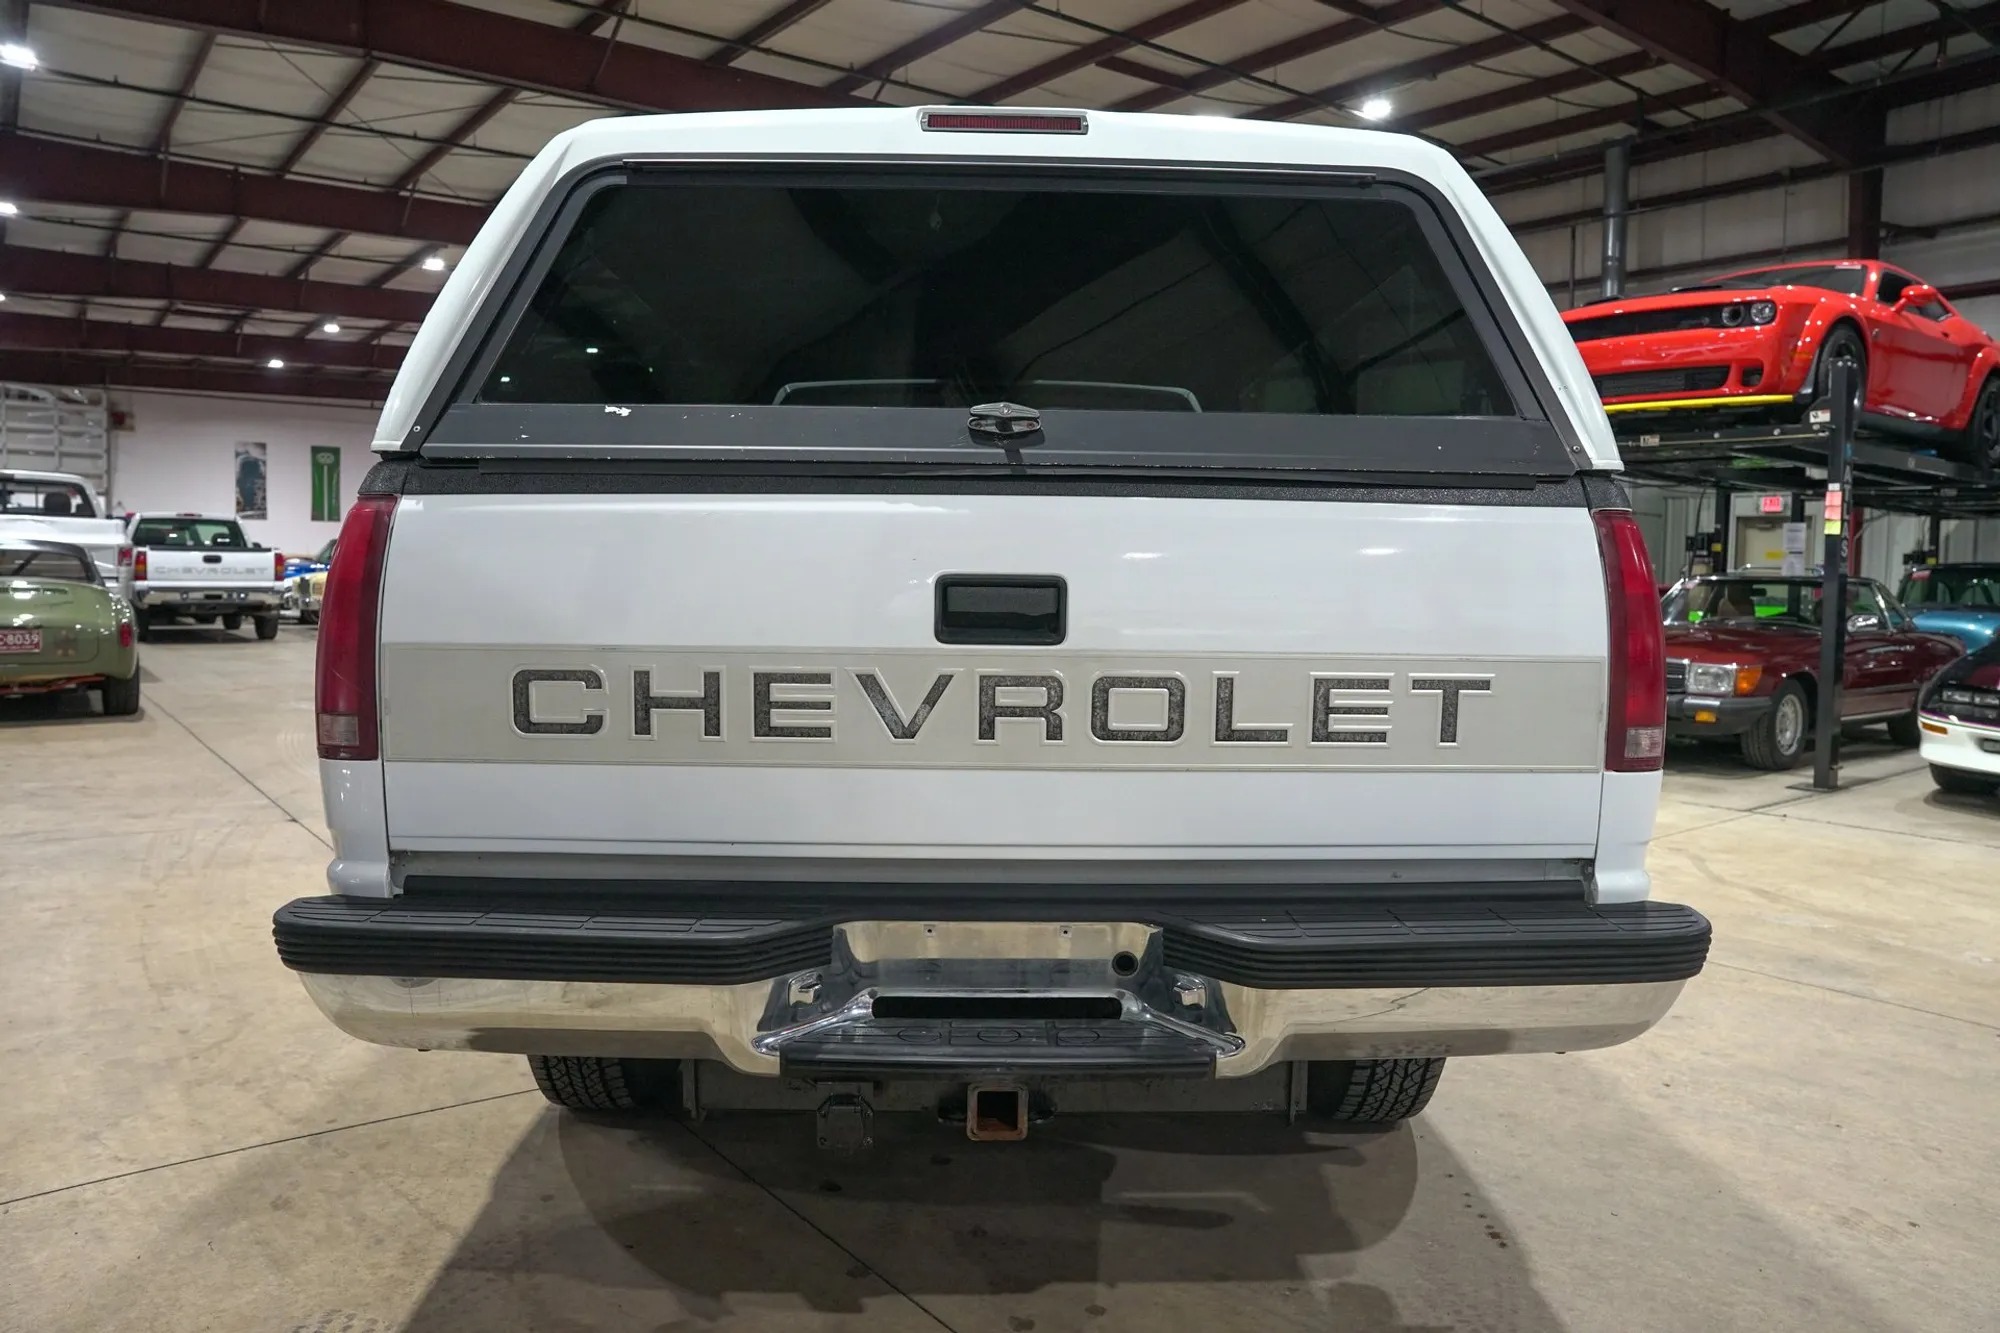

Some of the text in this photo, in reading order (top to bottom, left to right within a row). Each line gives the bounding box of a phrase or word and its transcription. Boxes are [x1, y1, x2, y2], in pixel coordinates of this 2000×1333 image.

[1762, 496, 1781, 512] EXIT
[154, 566, 268, 575] CHEVROLET
[511, 668, 1492, 743] CHEVROLET
